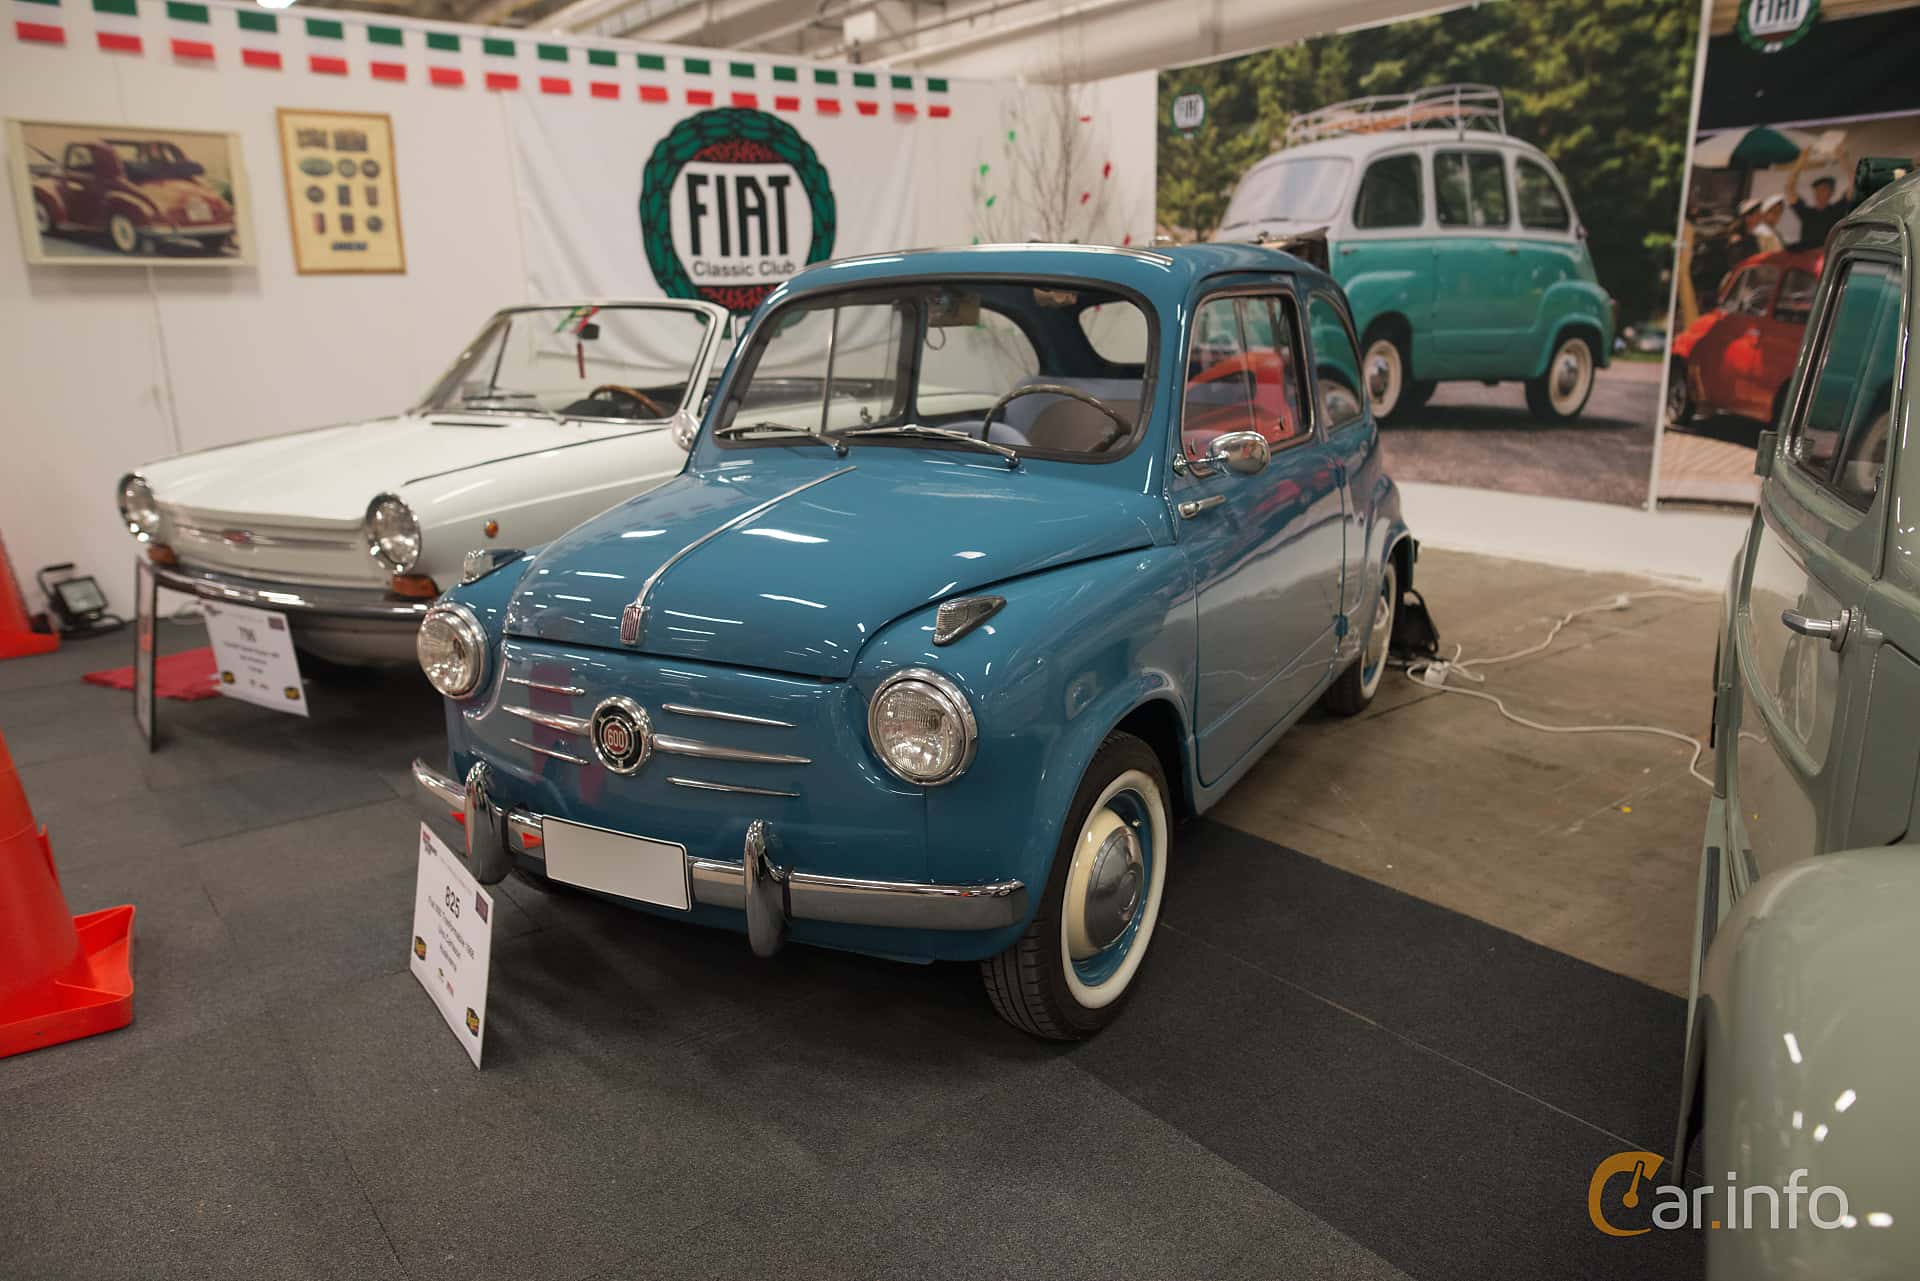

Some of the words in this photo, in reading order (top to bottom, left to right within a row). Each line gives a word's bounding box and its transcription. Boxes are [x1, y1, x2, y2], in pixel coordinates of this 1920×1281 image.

[686, 173, 790, 257] FIAT
[692, 259, 754, 277] Classic
[758, 258, 796, 276] Club
[608, 729, 624, 748] 600
[445, 885, 460, 919] 825
